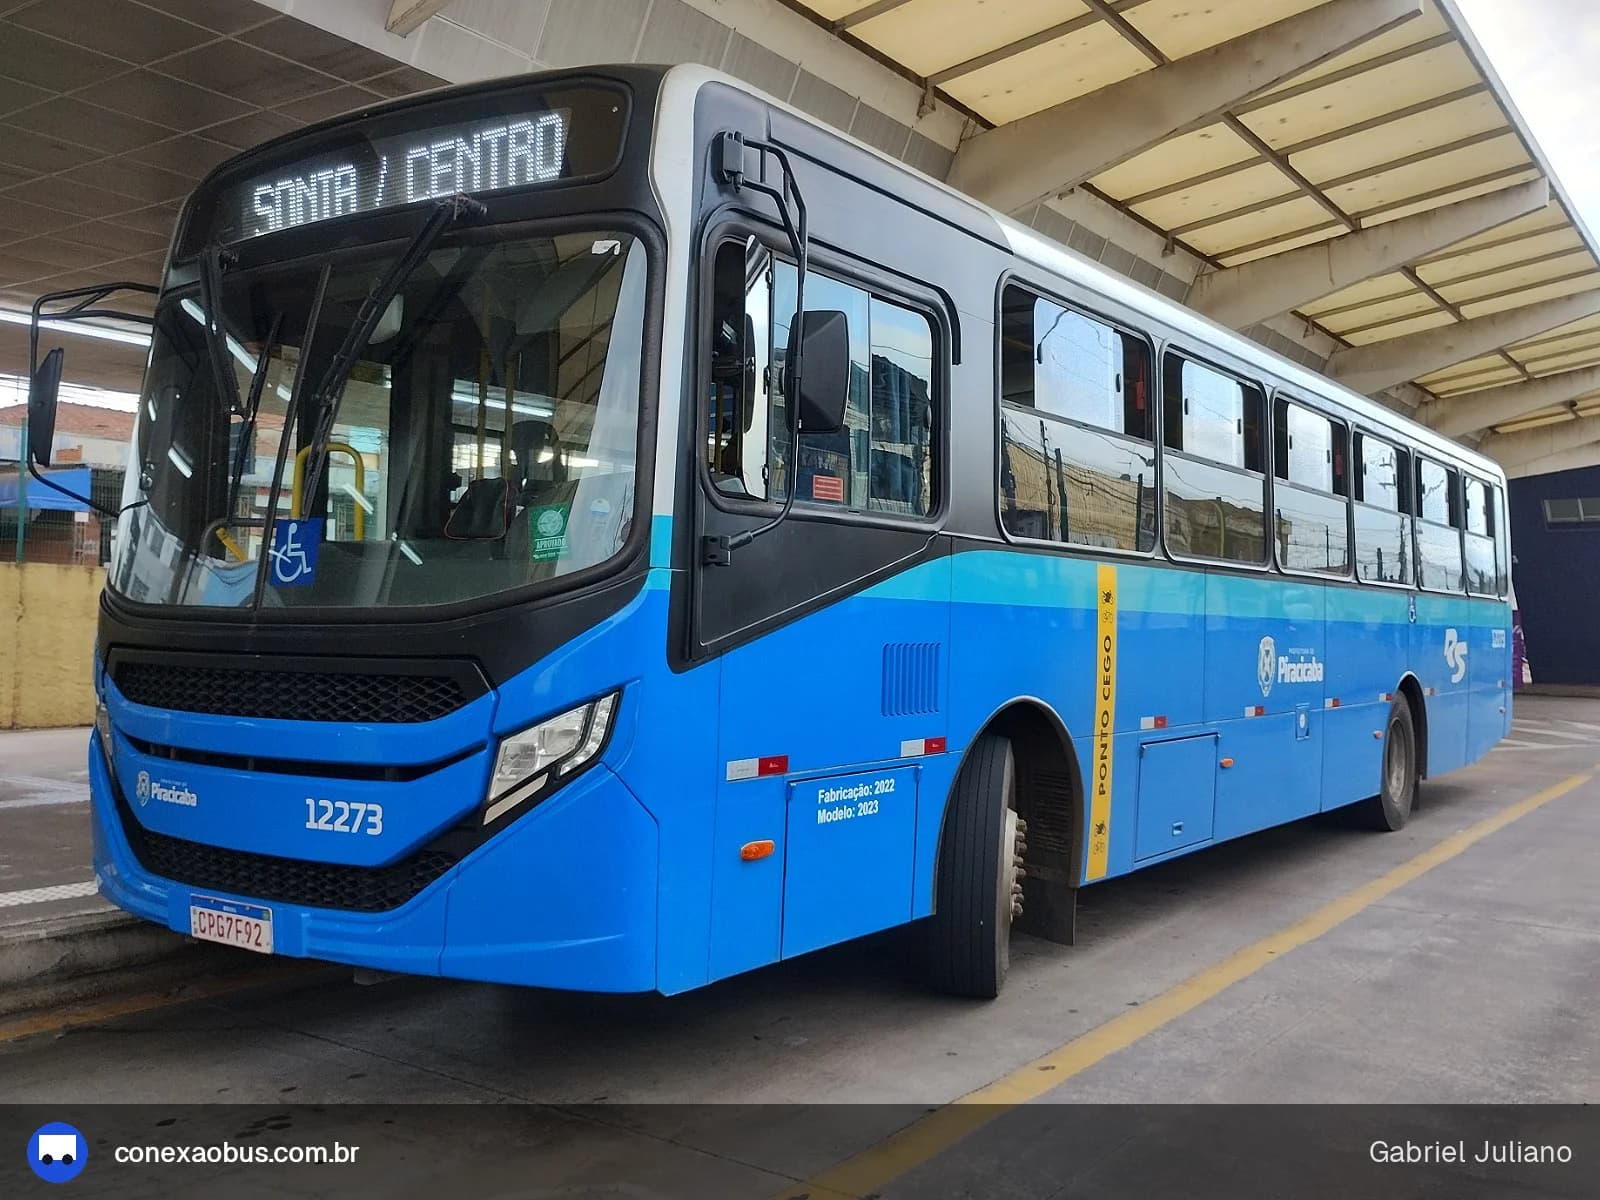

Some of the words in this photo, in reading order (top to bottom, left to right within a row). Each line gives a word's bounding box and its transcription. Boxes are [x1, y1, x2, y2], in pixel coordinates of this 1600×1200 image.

[405, 113, 564, 204] CENTRO
[1102, 635, 1112, 701] CEGO
[1277, 655, 1324, 684] Piracicaba
[1098, 710, 1110, 796] PONTO
[151, 782, 197, 807] Piracicaba
[818, 783, 873, 804] Fabricação:
[874, 778, 895, 795] 2022
[305, 798, 383, 836] 12273
[817, 805, 856, 825] Modelo:
[857, 799, 879, 817] 2023
[198, 911, 262, 947] CPG7F92
